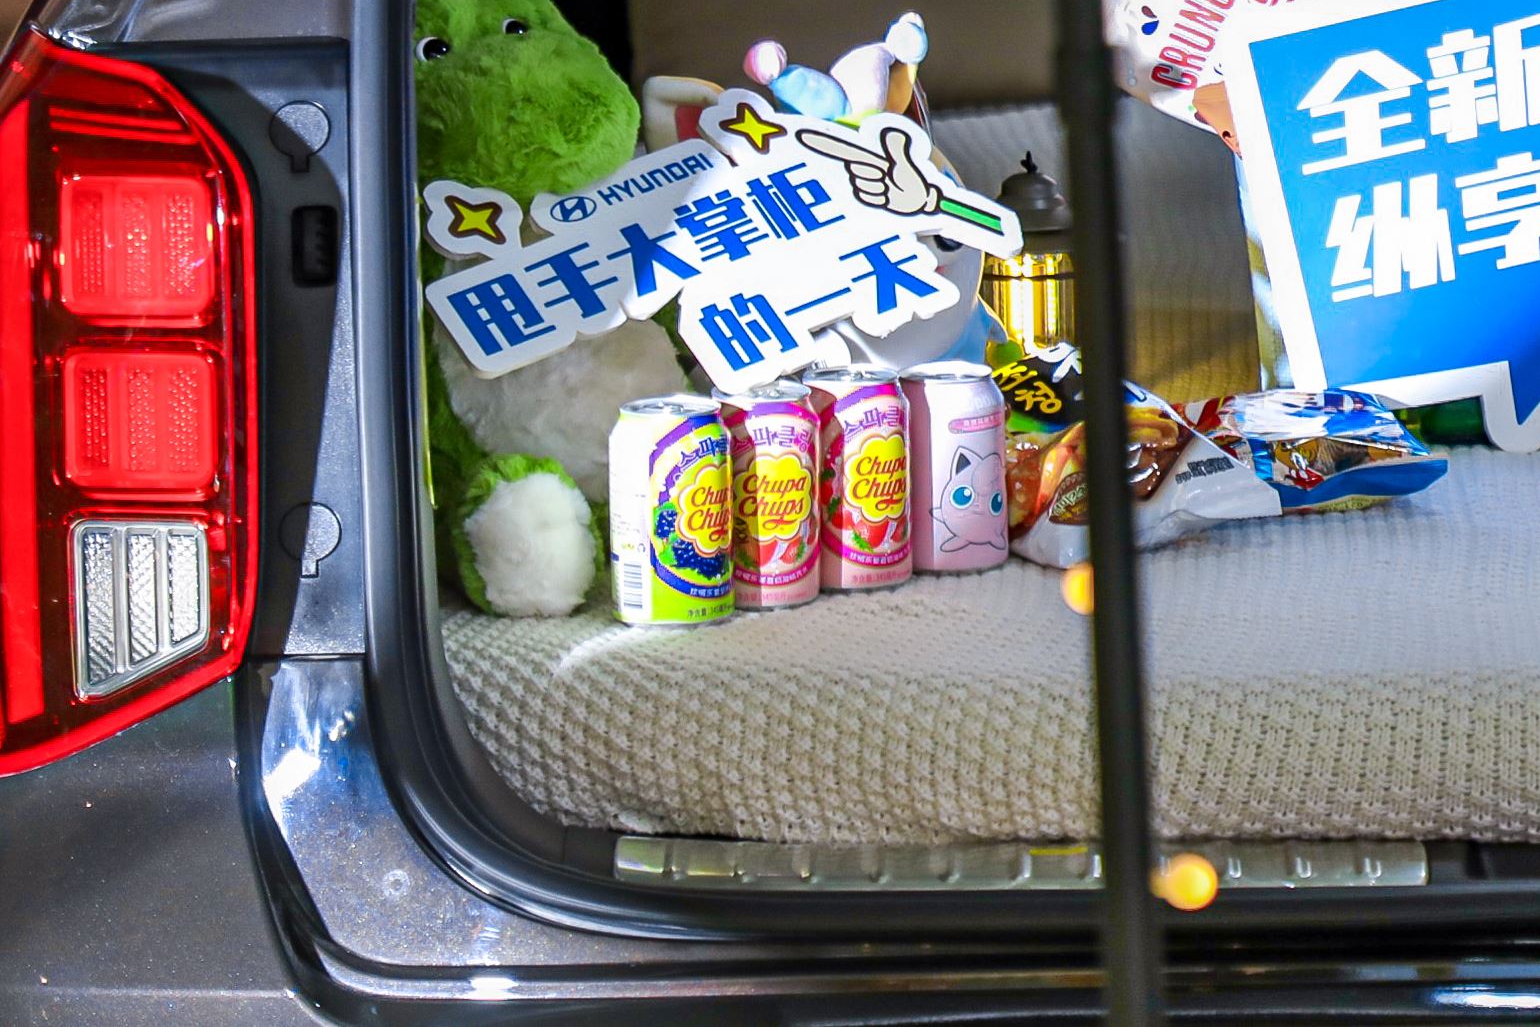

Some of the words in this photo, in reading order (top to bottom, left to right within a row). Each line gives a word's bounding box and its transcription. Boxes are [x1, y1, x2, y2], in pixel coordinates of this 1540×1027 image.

[597, 152, 714, 207] HYUNDAI
[446, 162, 846, 356] 甩手大掌柜
[699, 234, 938, 372] 的一天
[739, 495, 805, 523] Chups
[743, 474, 807, 497] Chupa
